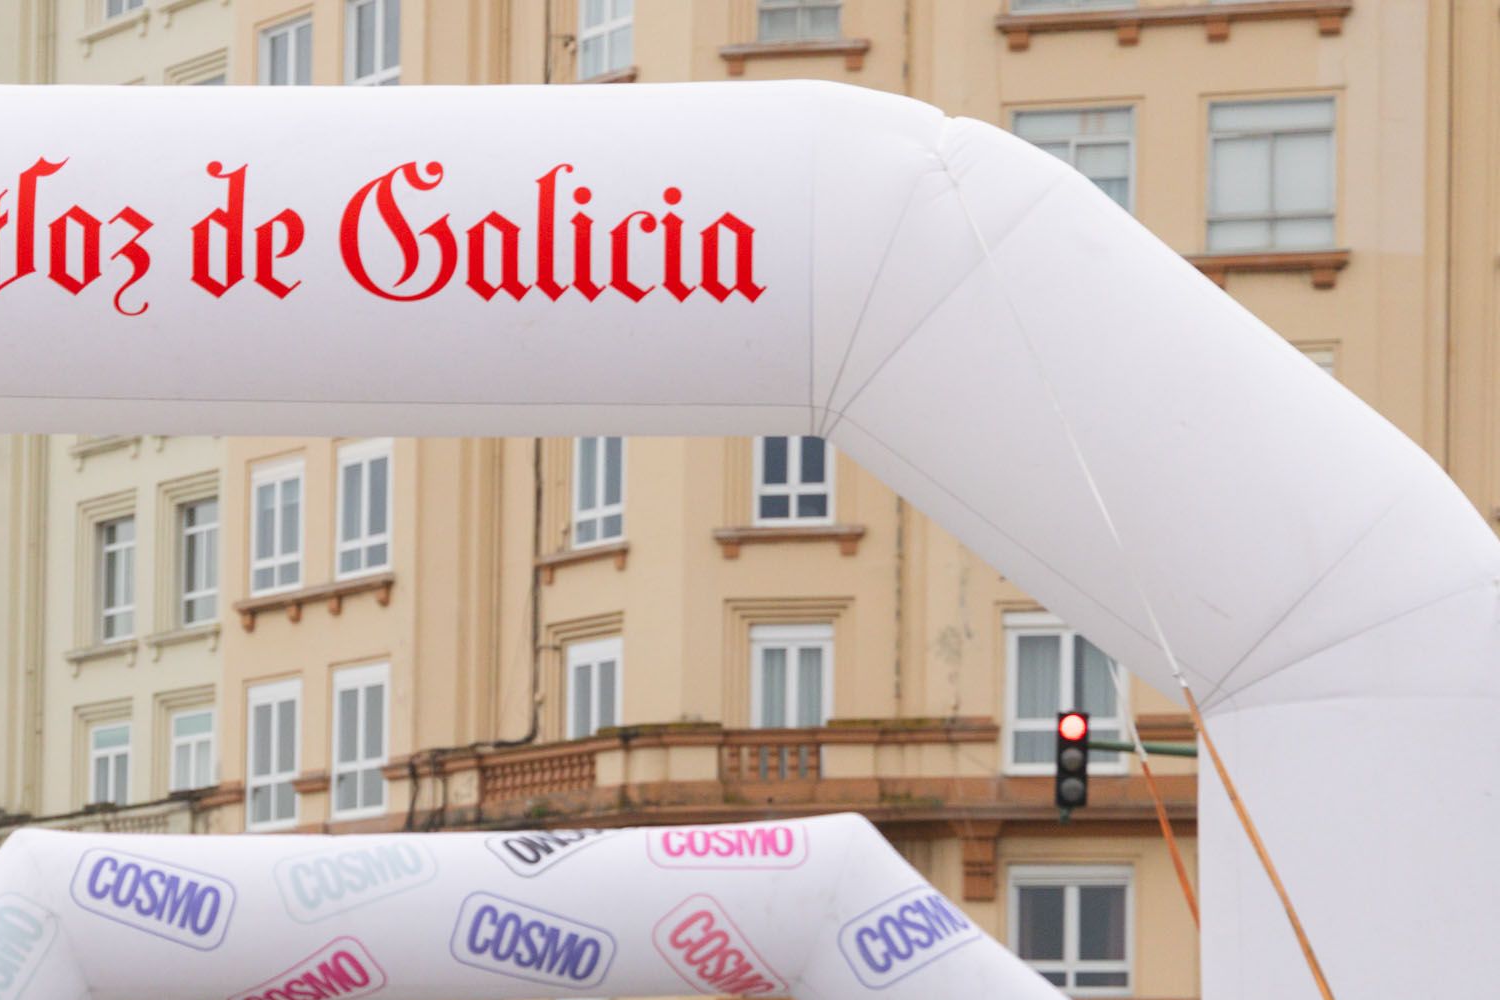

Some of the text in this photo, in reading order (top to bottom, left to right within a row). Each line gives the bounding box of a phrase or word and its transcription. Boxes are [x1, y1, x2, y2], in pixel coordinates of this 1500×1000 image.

[190, 160, 305, 299] de
[338, 160, 767, 304] Galicia
[289, 839, 424, 909] COSMO
[662, 828, 795, 858] COSMO
[88, 856, 222, 936] COSMO
[467, 904, 601, 980] COSMO
